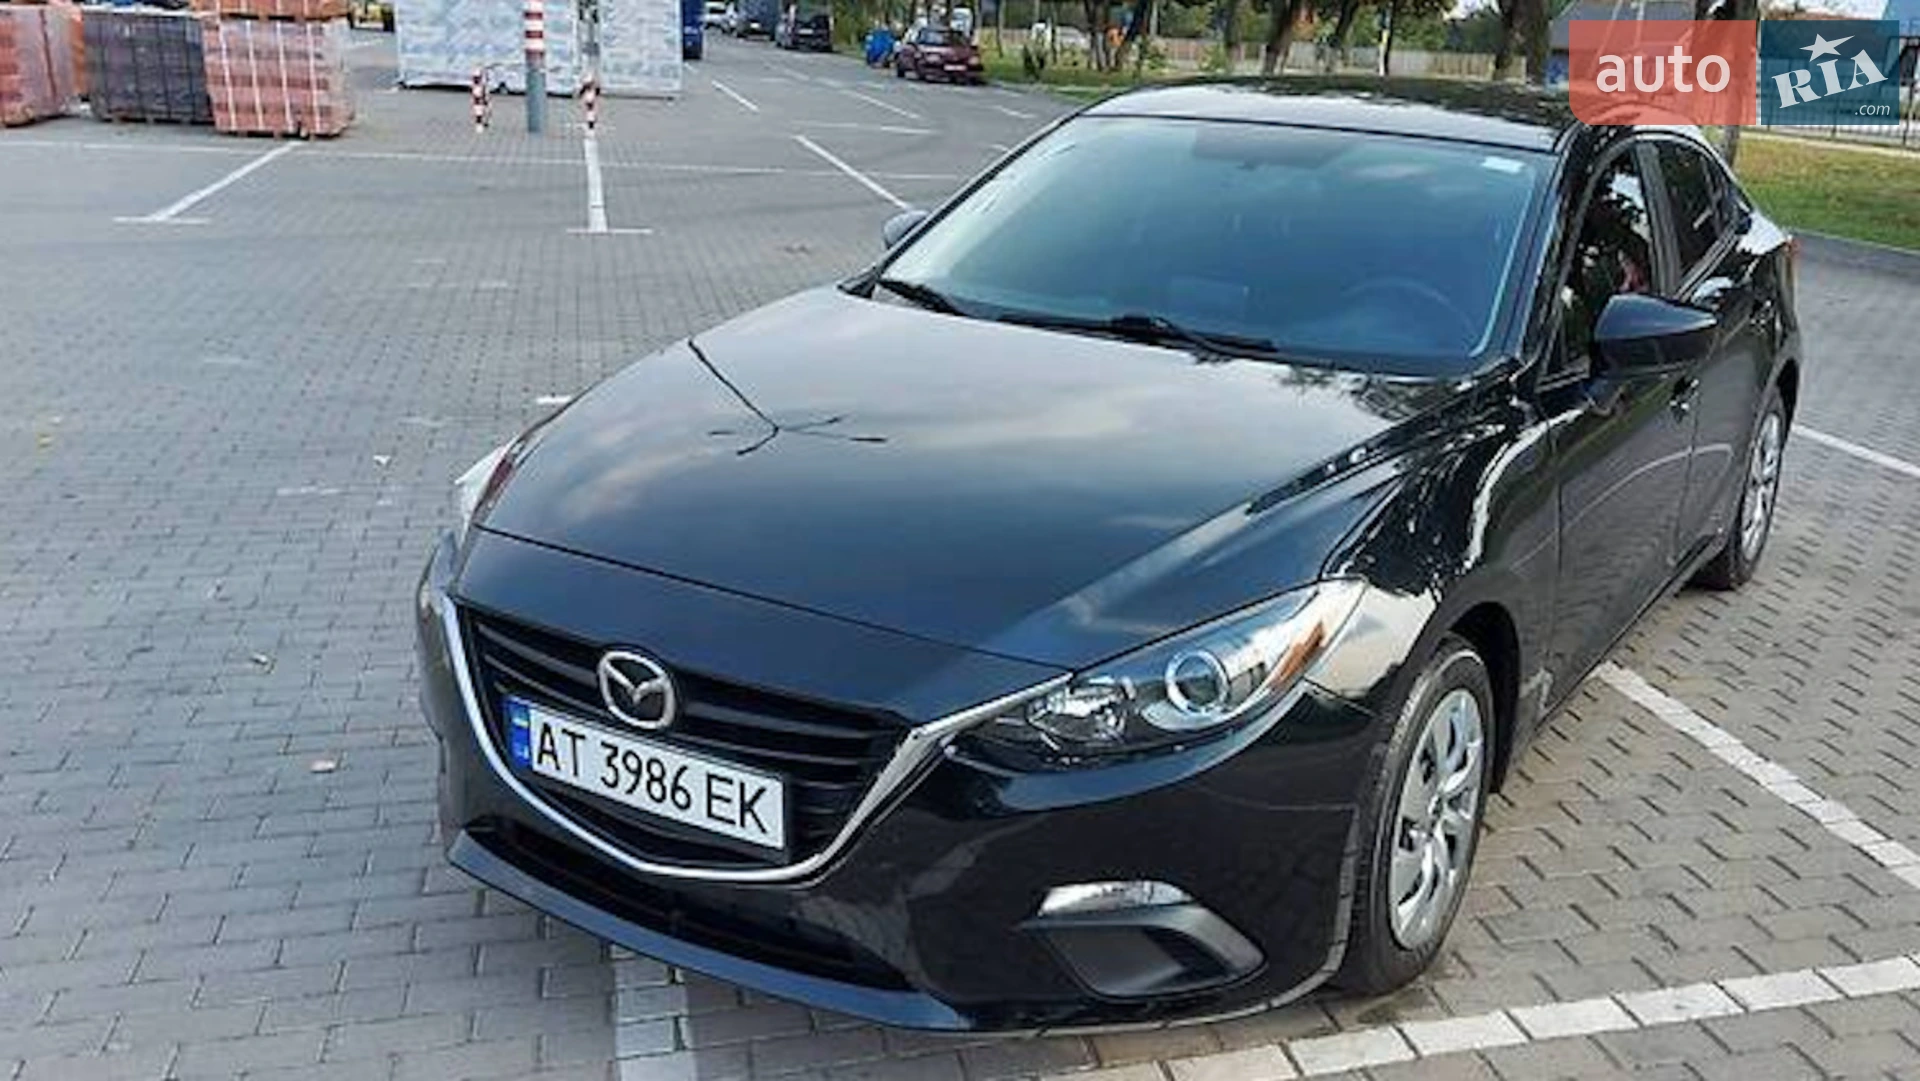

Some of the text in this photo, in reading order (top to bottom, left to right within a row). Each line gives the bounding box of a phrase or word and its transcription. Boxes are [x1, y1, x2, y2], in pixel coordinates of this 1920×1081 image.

[537, 722, 768, 834] AT 3986 EK
